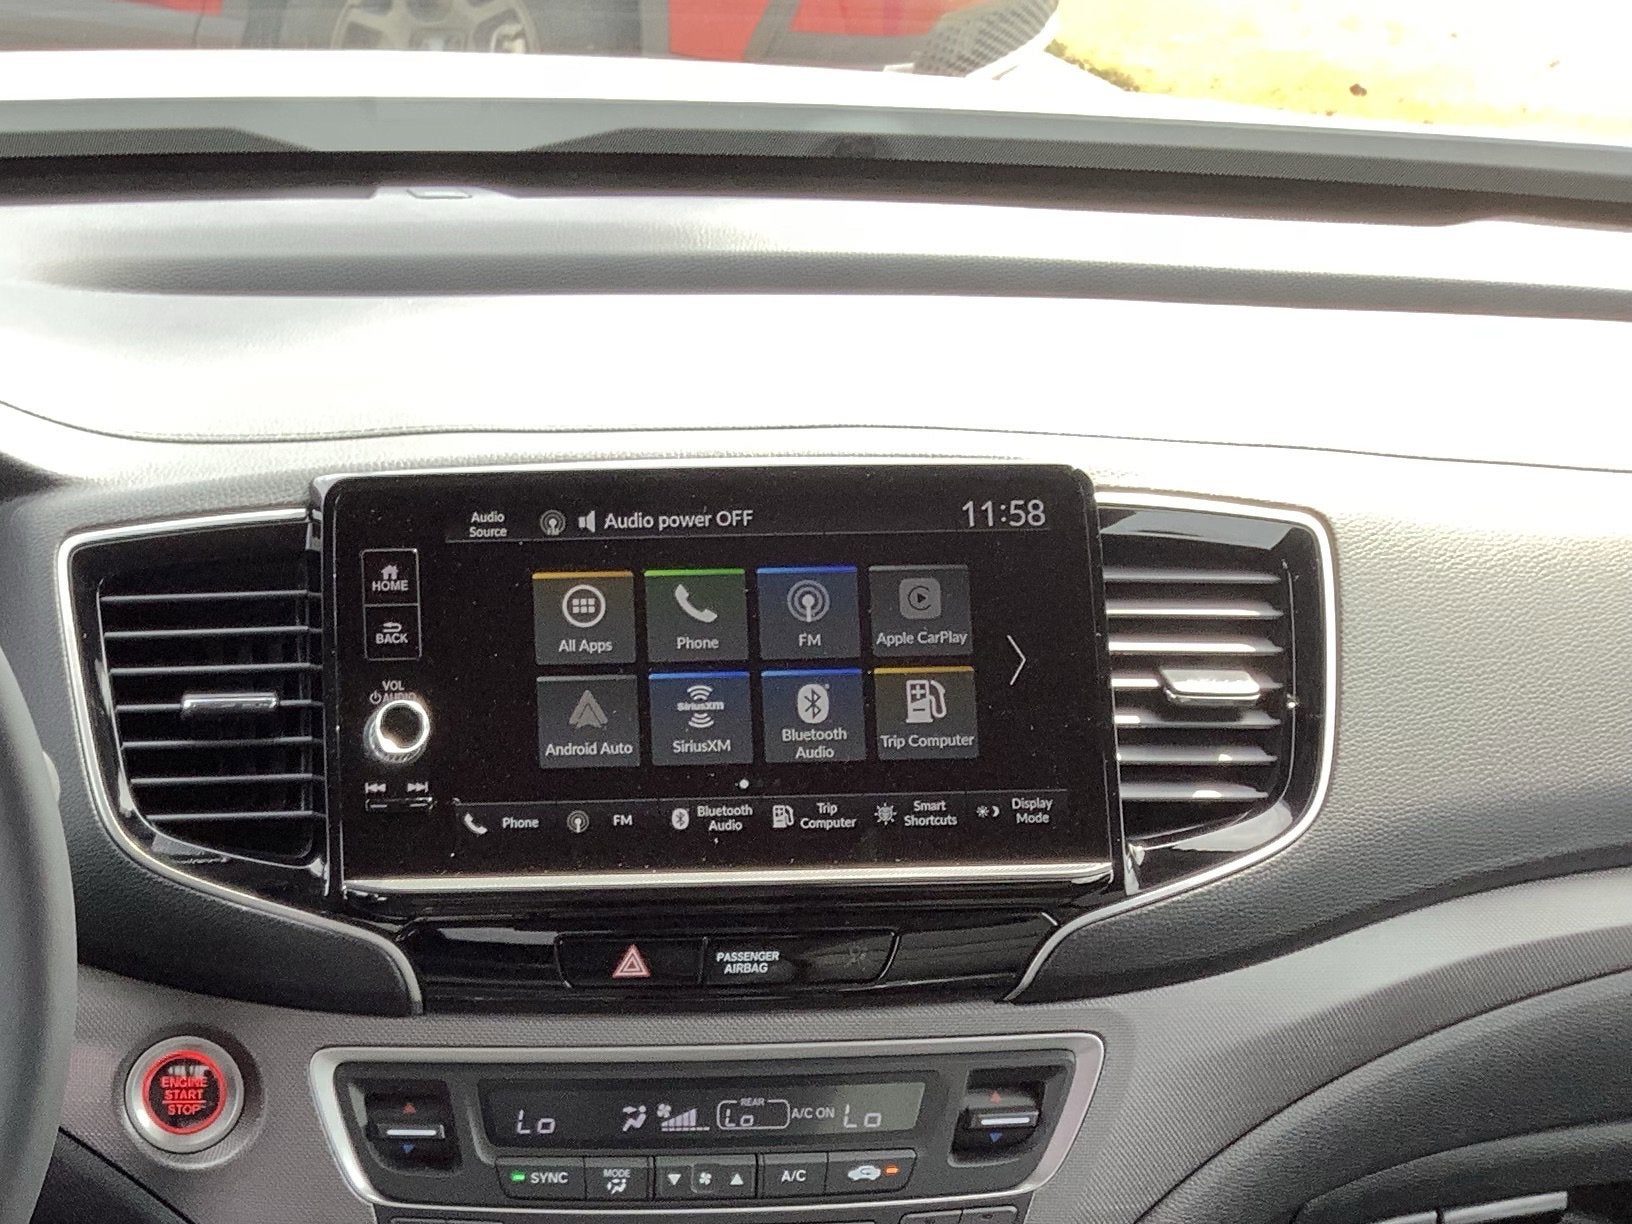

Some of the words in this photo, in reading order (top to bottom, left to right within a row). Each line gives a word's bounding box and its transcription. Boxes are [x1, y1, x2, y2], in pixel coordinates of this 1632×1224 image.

[470, 511, 506, 524] Audio
[962, 500, 1046, 527] 11:58
[604, 512, 655, 530] Audio
[658, 514, 711, 531] power
[716, 510, 754, 526] OFF
[469, 526, 508, 537] Source
[372, 580, 409, 592] HOME
[375, 632, 408, 645] BACK
[676, 636, 719, 650] Phone
[798, 633, 821, 646] FM
[876, 631, 915, 647] Apple
[917, 630, 968, 646] CarPlay
[558, 639, 577, 652] All
[579, 639, 613, 654] Apps
[382, 681, 405, 691] VOL
[781, 728, 847, 742] Bluetooth
[672, 739, 731, 753] SiriusXM
[880, 735, 906, 751] Trip
[908, 734, 975, 750] Computer
[545, 743, 597, 757] Android
[600, 742, 633, 755] Auto
[795, 746, 834, 759] Audio
[697, 805, 753, 817] Bluetooth
[816, 803, 838, 817] Trip
[913, 800, 946, 812] Smart
[1011, 798, 1053, 812] Display
[502, 817, 539, 830] Phone
[613, 815, 633, 826] FM
[800, 817, 857, 831] Computer
[904, 813, 957, 826] Shortcuts
[1016, 812, 1050, 824] Mode
[708, 819, 743, 832] Audio
[716, 951, 780, 963] PASSENGER
[724, 962, 769, 975] AIRBAG
[160, 1076, 208, 1088] ENGINE
[164, 1089, 204, 1100] START
[740, 1097, 765, 1106] REAR
[168, 1104, 201, 1116] STOP
[792, 1106, 814, 1119] A/C
[816, 1106, 835, 1119] ON
[843, 1104, 882, 1128] Lo
[517, 1109, 556, 1135] Lo
[725, 1108, 754, 1127] Lo
[530, 1172, 568, 1184] SYNC
[603, 1169, 631, 1178] MODE
[781, 1169, 807, 1183] A/C
